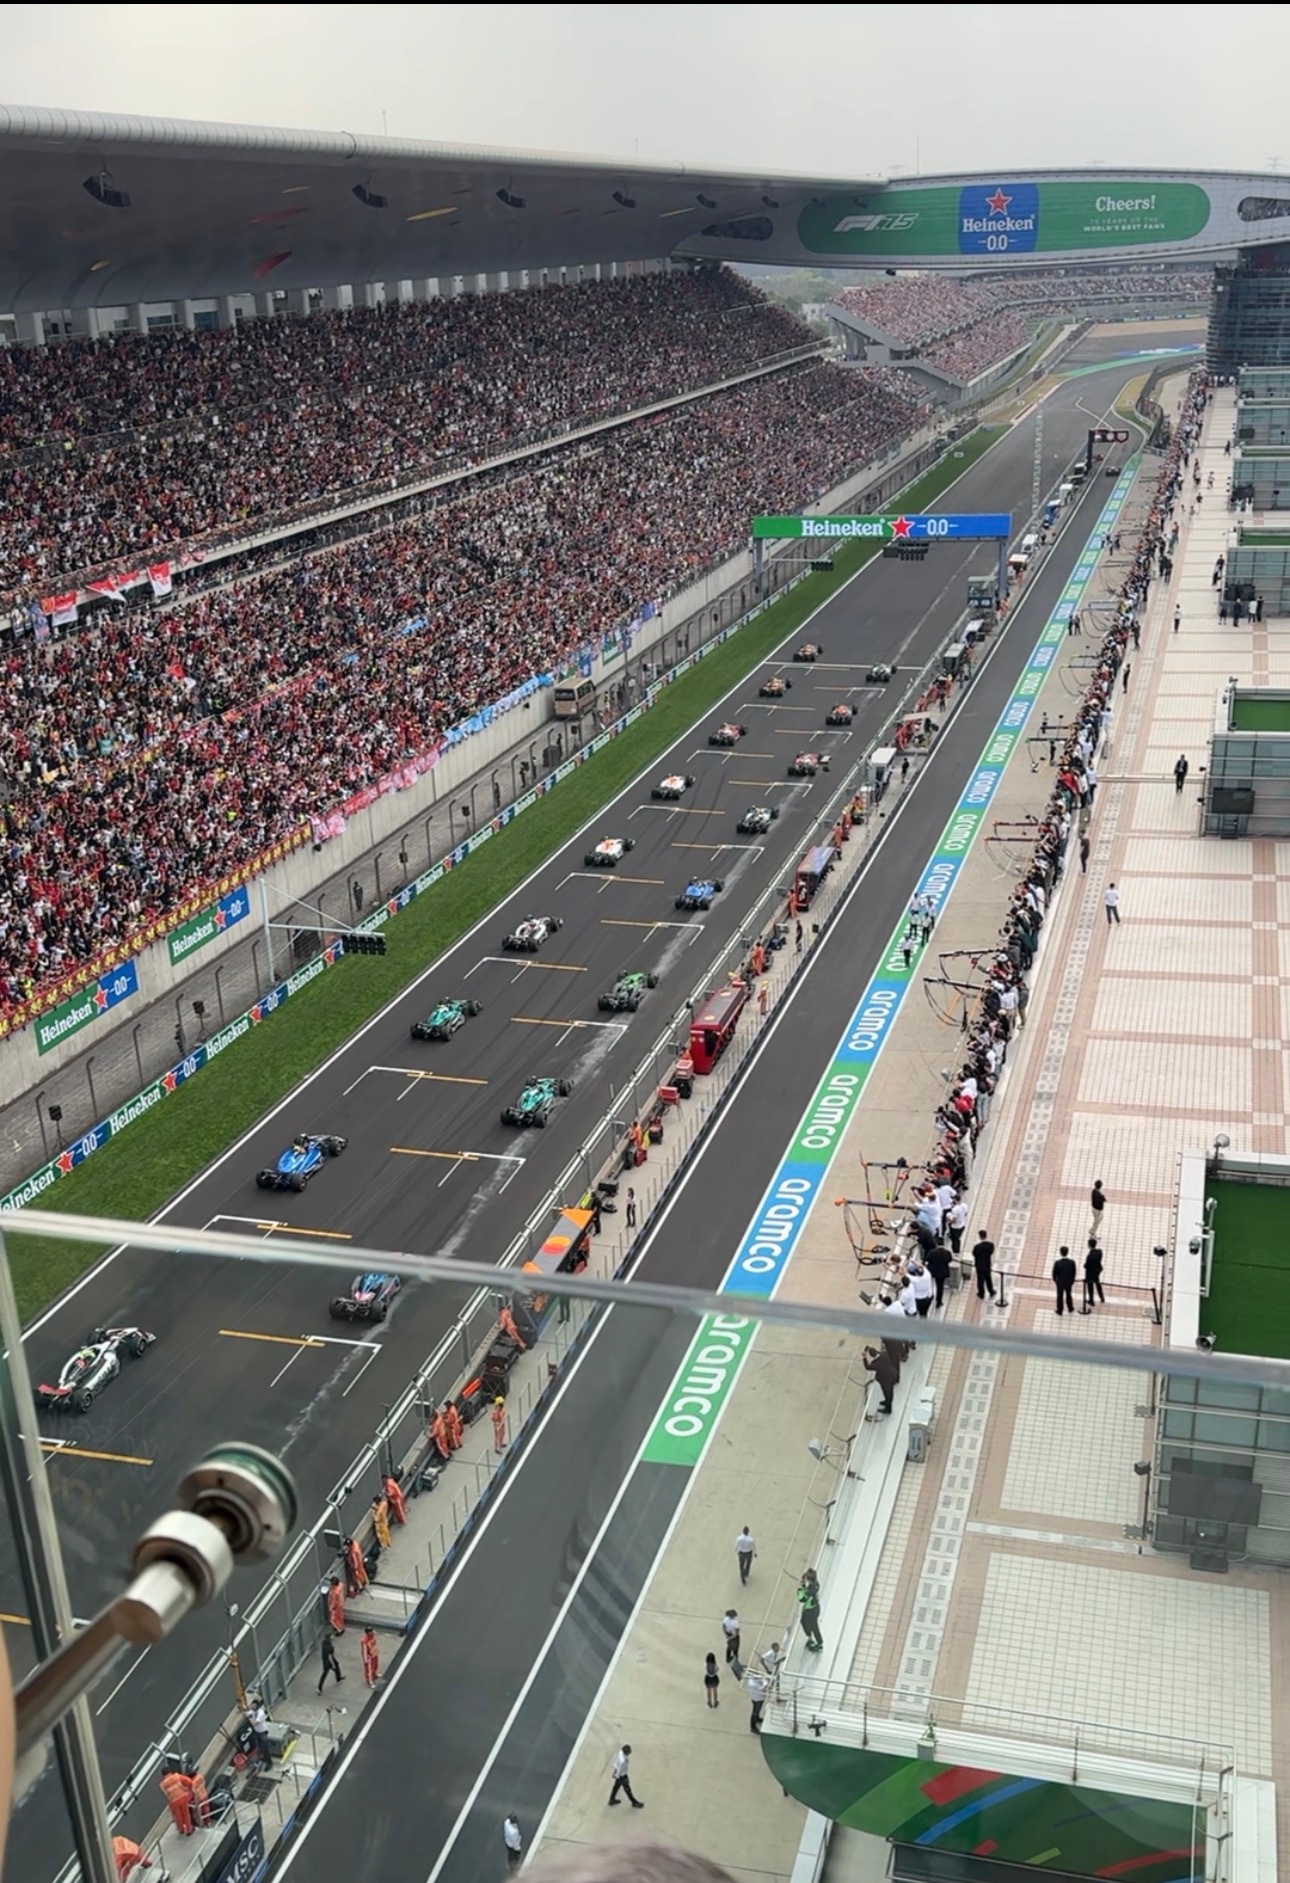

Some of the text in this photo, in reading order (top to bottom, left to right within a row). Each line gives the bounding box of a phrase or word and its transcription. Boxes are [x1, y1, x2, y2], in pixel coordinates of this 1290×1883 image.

[962, 216, 1034, 233] Heineken
[1095, 194, 1156, 212] Cheers!
[801, 520, 884, 537] Heineken
[944, 813, 978, 851] aramco
[171, 920, 214, 958] Heineken
[39, 1003, 93, 1046] Heineken
[848, 990, 897, 1051] aramco
[110, 1087, 161, 1136] Heineken
[801, 1074, 859, 1149] aramco
[0, 1169, 55, 1213] eineken
[742, 1178, 812, 1273] aramco
[664, 1313, 749, 1437] aramco
